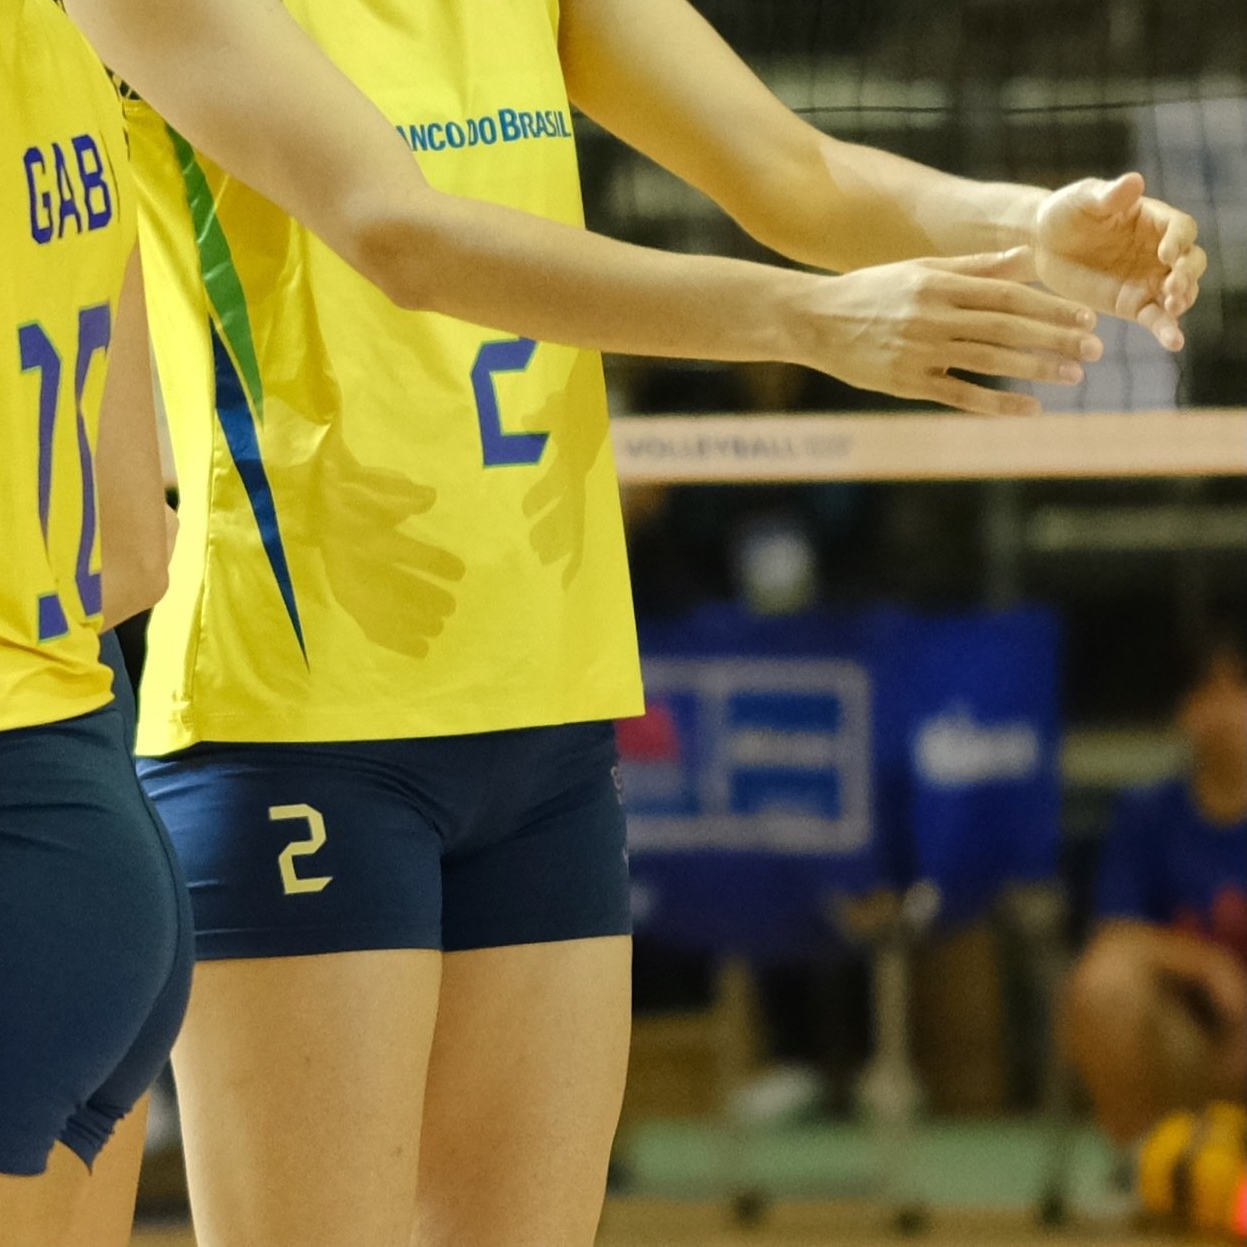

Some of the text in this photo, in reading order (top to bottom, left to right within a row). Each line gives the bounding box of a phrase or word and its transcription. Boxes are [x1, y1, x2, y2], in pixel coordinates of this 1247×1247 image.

[466, 116, 498, 147] DO
[23, 131, 121, 244] GAB
[470, 336, 550, 468] 2
[268, 803, 333, 895] 2
